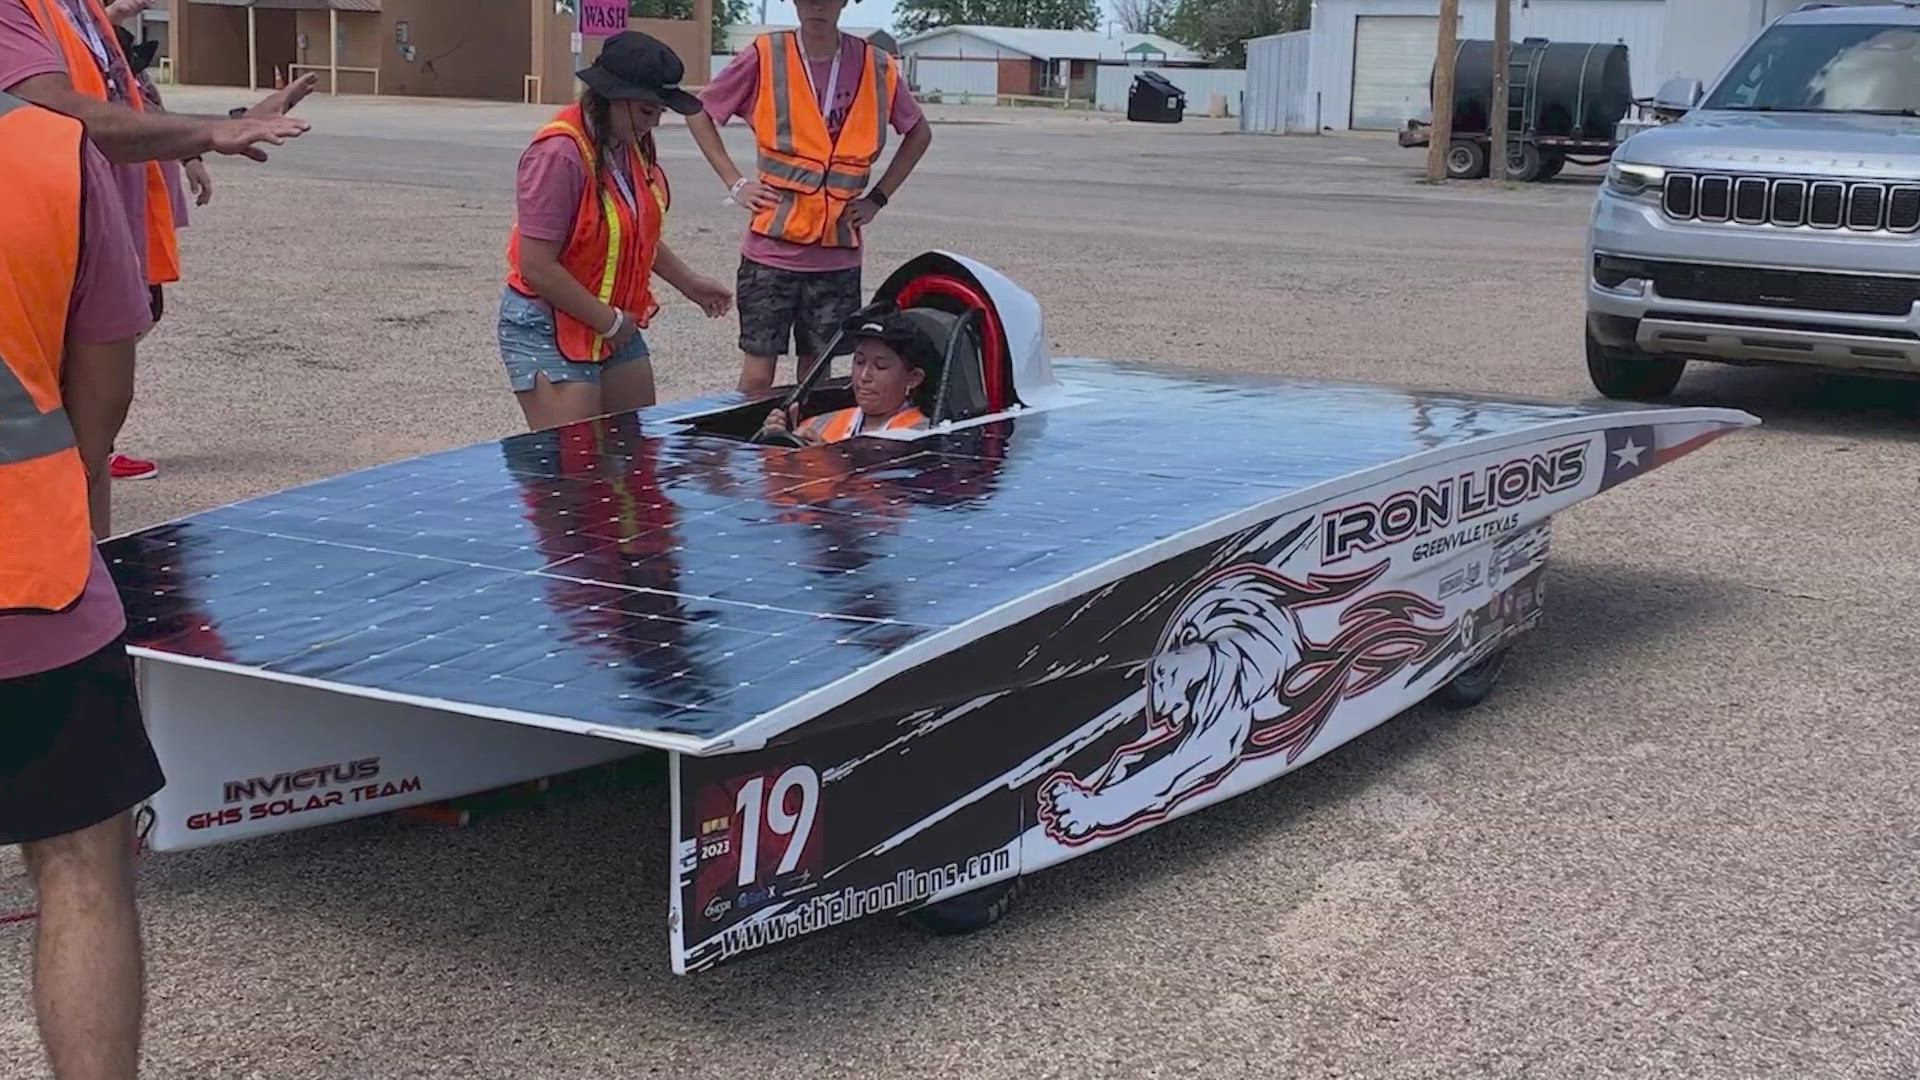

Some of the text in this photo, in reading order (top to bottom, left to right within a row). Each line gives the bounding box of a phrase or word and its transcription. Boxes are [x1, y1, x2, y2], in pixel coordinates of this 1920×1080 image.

[584, 5, 626, 28] WASH
[1320, 440, 1592, 566] IRON LIONS
[186, 776, 422, 830] GHS SOLAR TEAM
[223, 757, 381, 804] INVICTUS
[700, 840, 730, 860] 2023
[735, 764, 820, 887] 19
[719, 848, 1010, 960] www.theironlions.com
